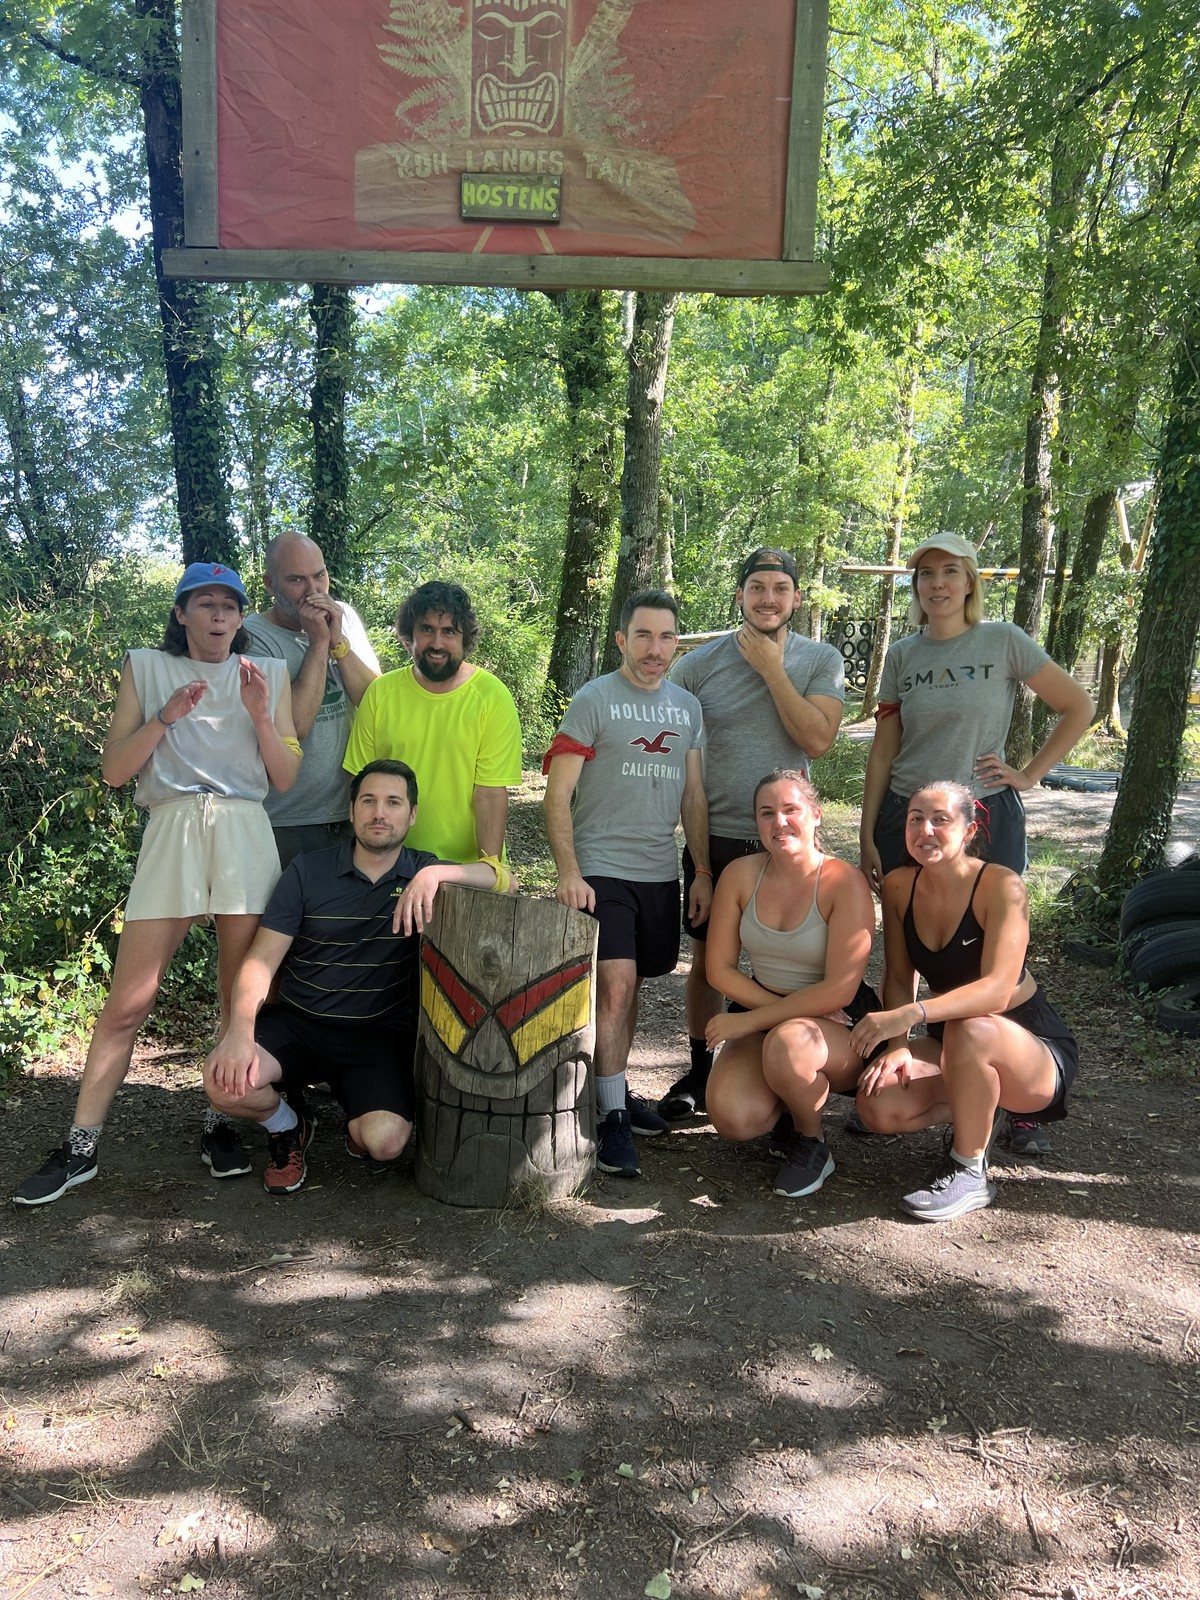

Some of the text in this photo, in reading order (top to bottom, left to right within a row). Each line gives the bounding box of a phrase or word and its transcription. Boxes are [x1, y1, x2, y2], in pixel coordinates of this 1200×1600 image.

[394, 151, 448, 178] KOH
[466, 148, 565, 176] LANDES
[463, 182, 560, 212] HOSTENS
[904, 664, 994, 692] SMART
[610, 703, 691, 726] HOLLISTER
[622, 762, 681, 780] CALIFORNIA
